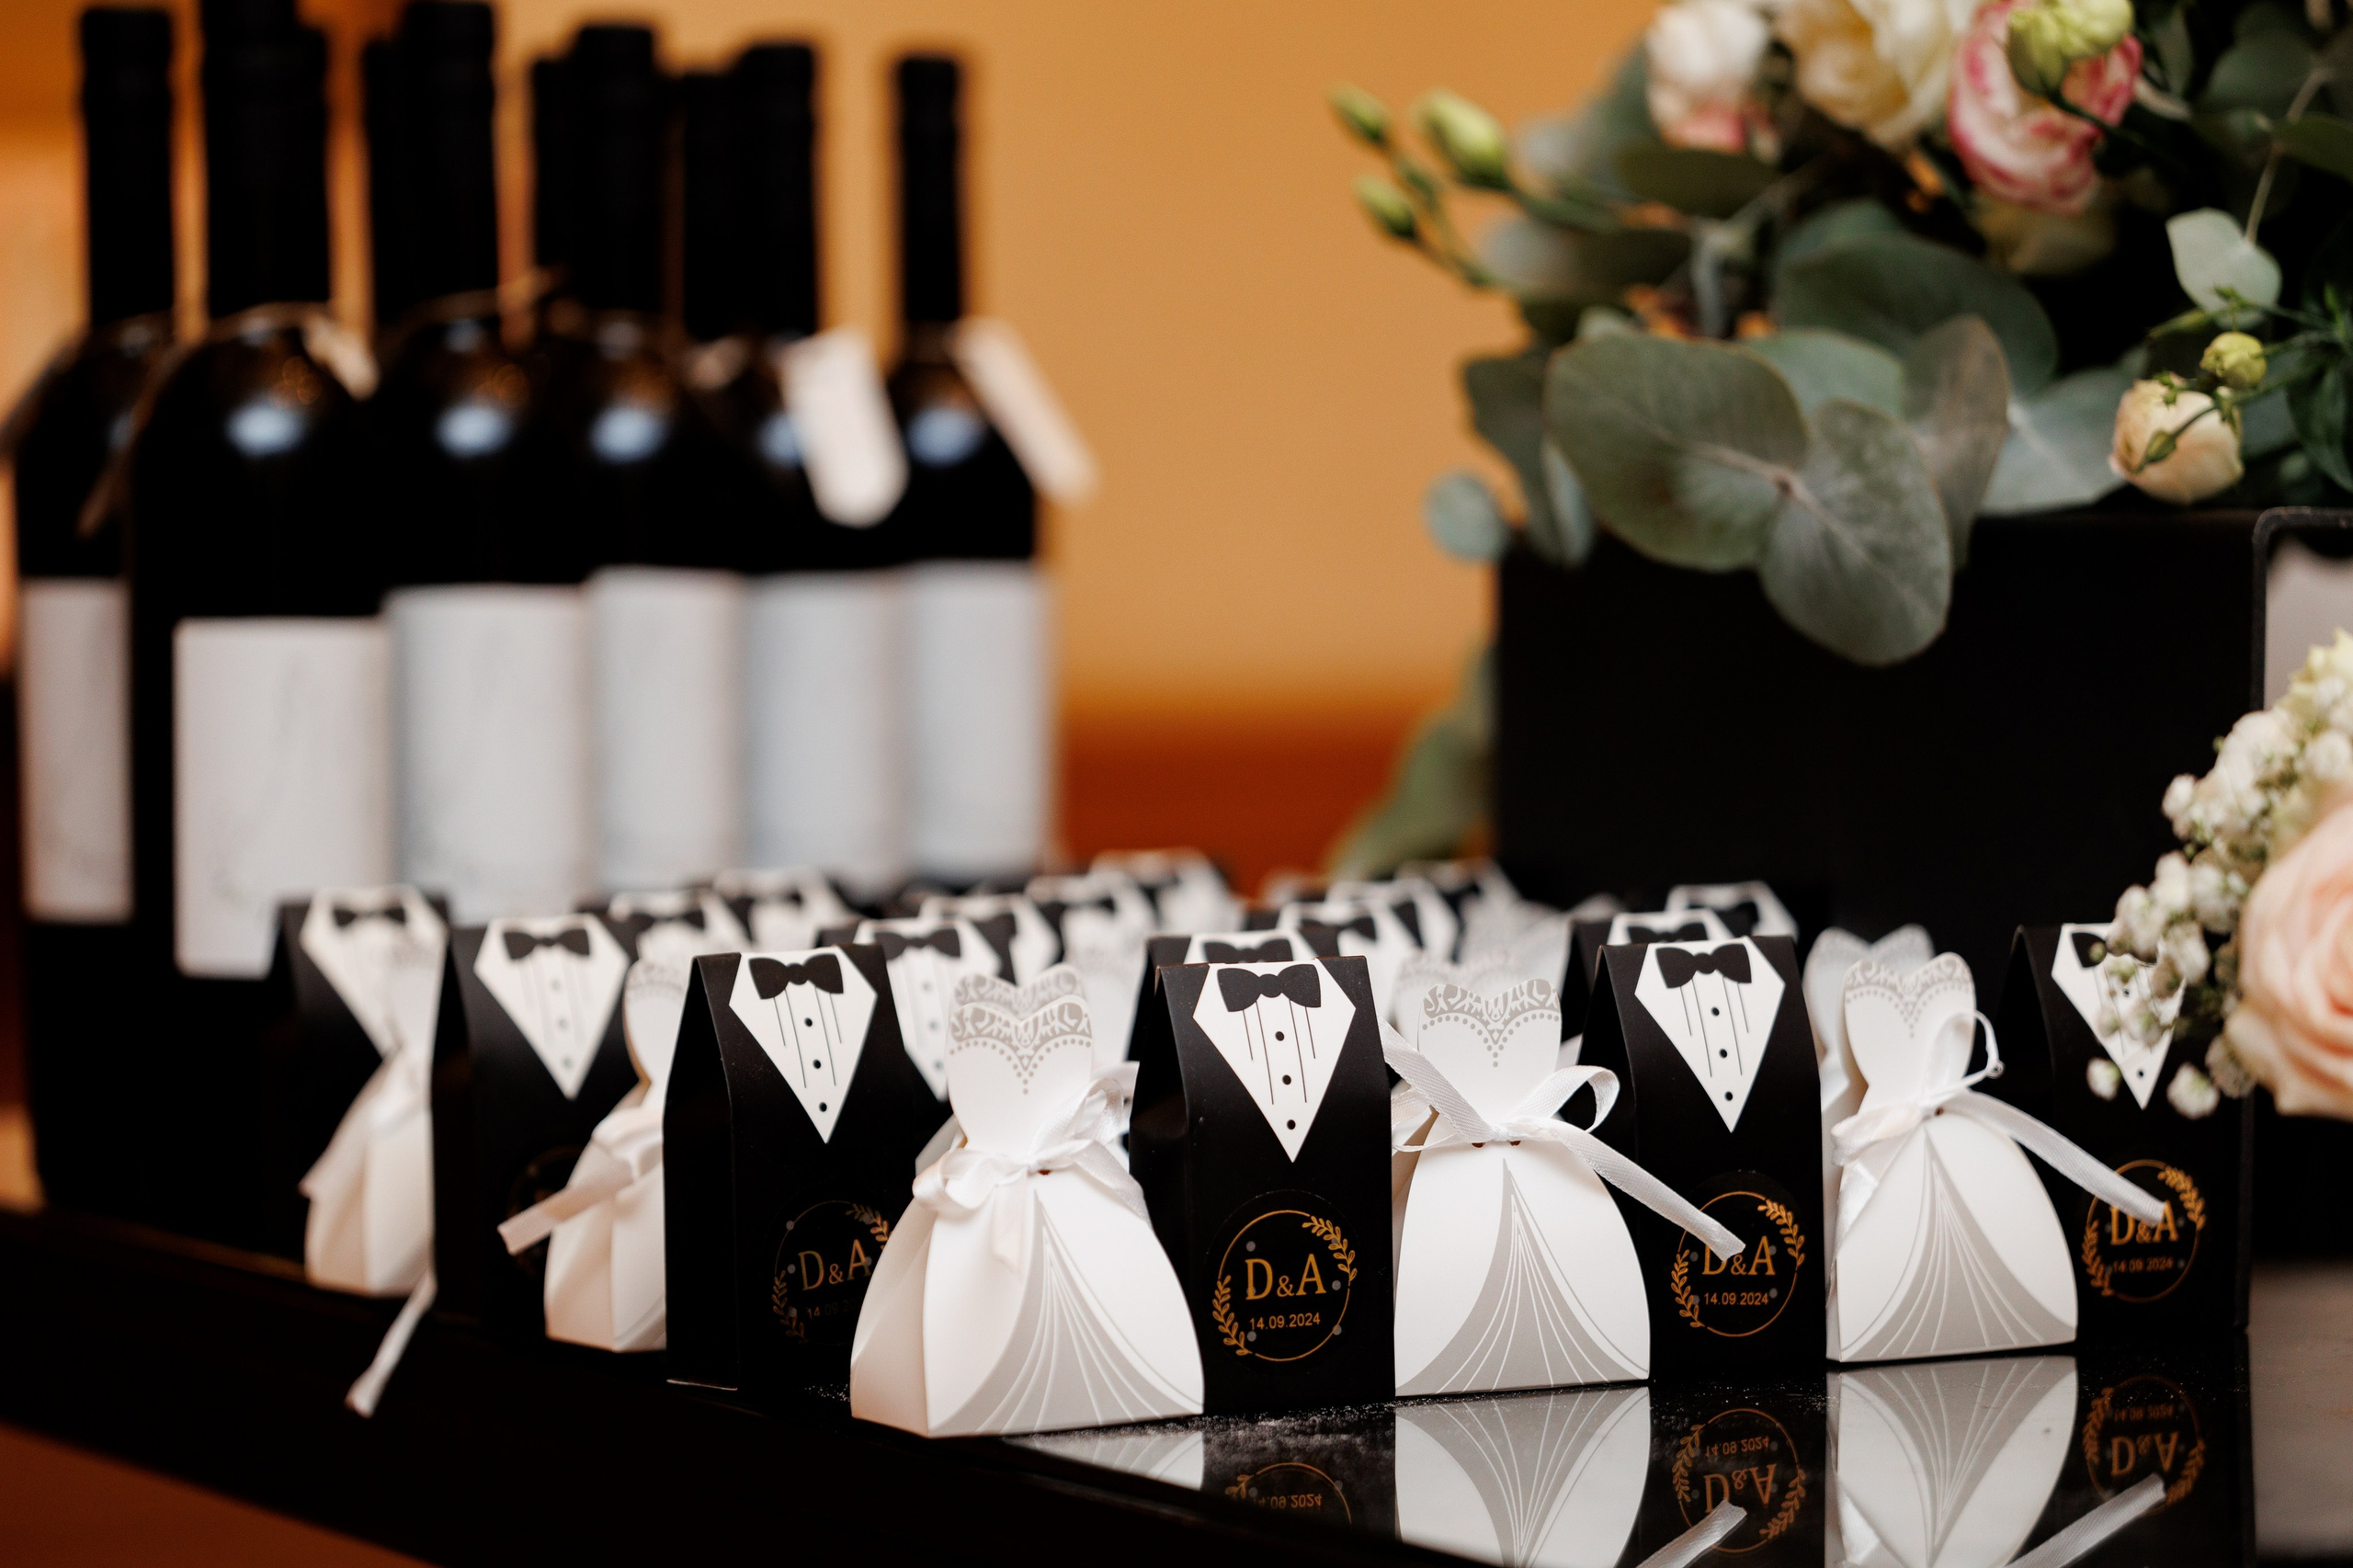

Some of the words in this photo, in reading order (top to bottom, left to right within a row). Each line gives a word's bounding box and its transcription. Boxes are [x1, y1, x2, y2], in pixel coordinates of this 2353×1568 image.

[798, 1238, 871, 1291] D&A
[2112, 1256, 2175, 1273] 14.09.2024
[1245, 1253, 1326, 1301] D&A
[1704, 1291, 1769, 1306] 14.09.2024
[1250, 1312, 1321, 1331] 14.09.2024
